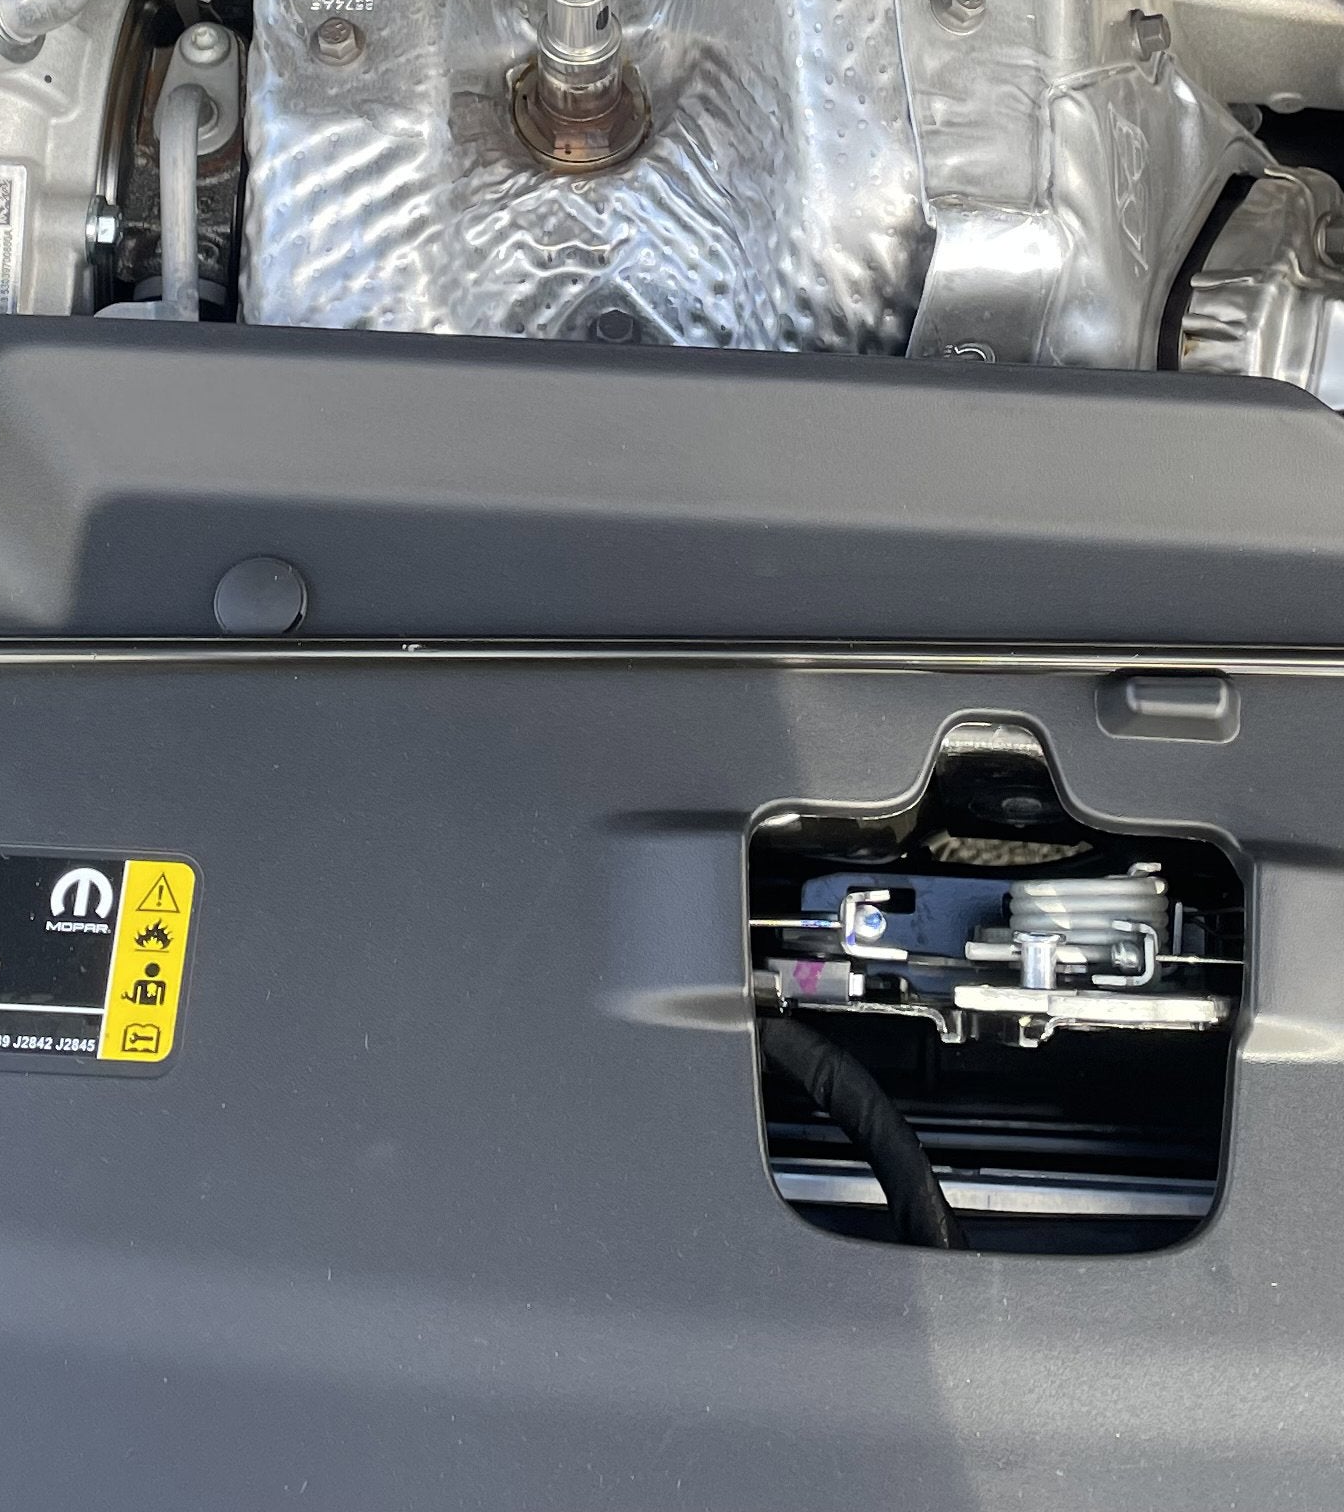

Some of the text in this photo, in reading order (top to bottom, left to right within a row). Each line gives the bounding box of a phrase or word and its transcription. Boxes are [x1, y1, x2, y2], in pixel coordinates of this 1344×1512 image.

[45, 919, 110, 934] MOPAR
[11, 1035, 54, 1051] J2842
[55, 1036, 97, 1053] J2845
